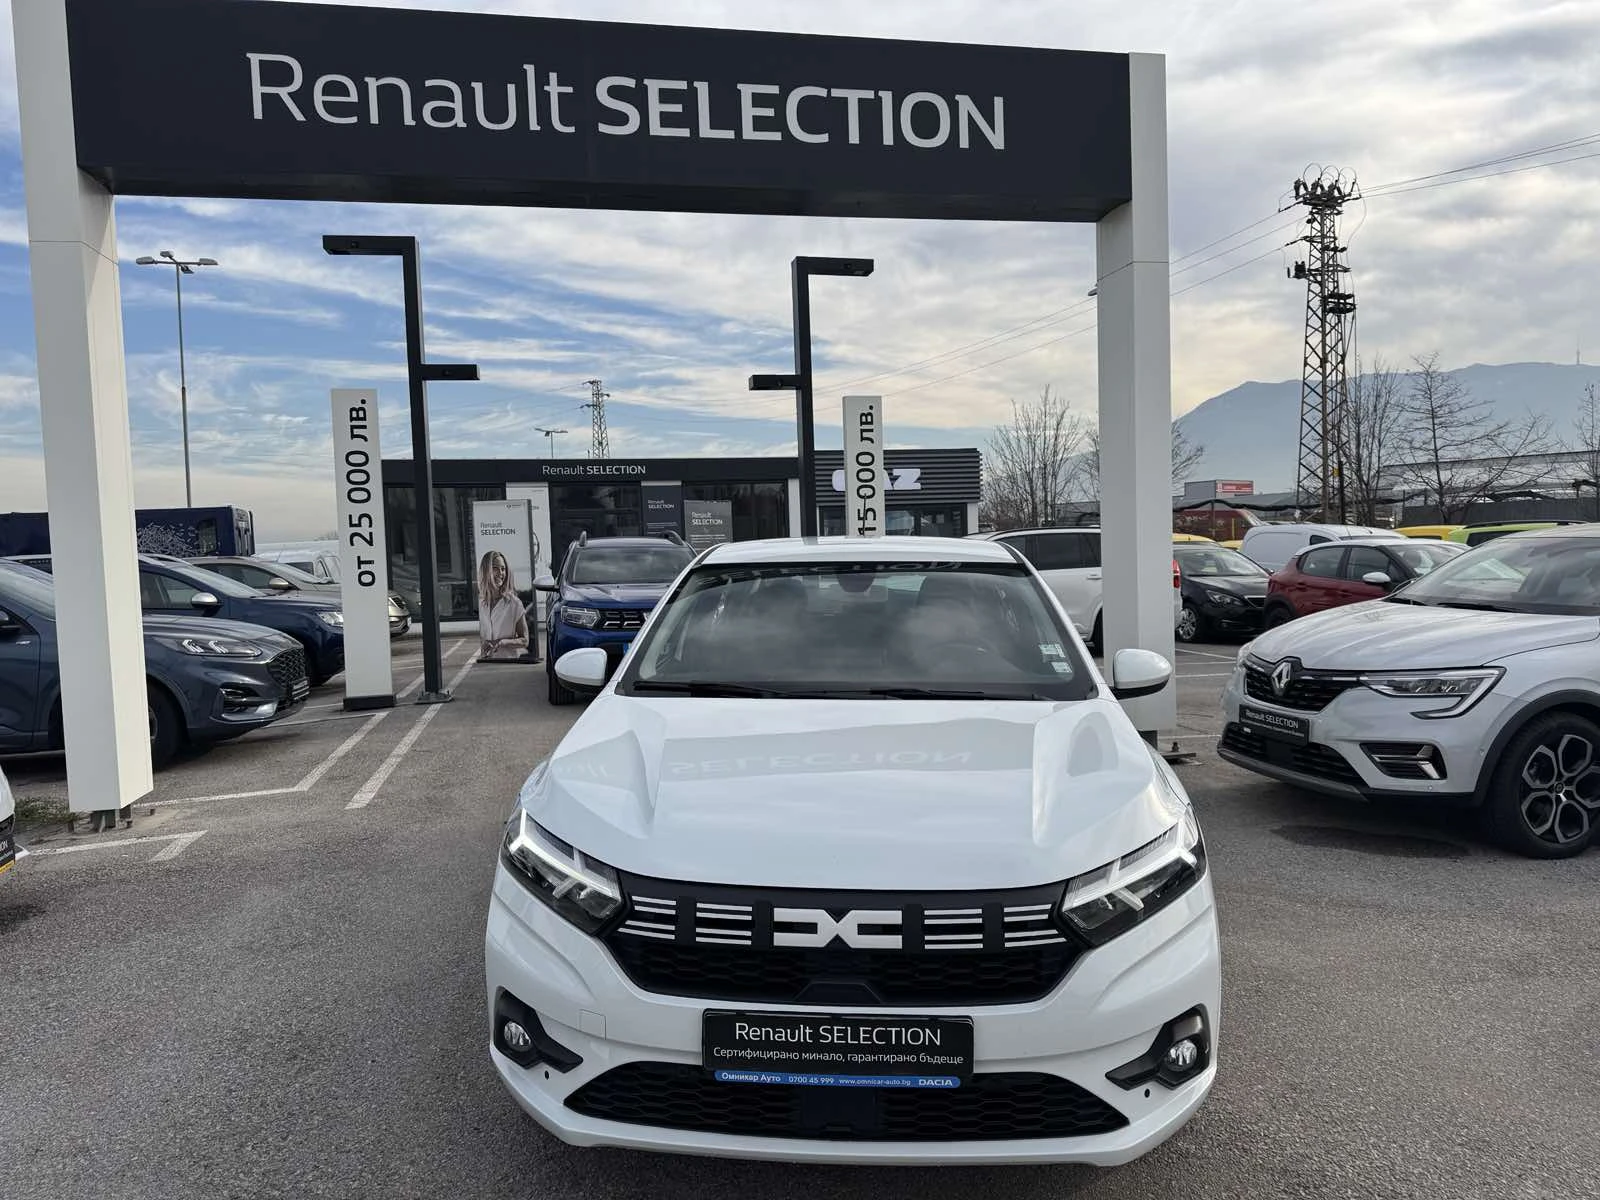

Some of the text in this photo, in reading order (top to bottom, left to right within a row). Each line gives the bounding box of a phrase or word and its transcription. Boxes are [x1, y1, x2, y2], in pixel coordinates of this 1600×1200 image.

[245, 52, 1005, 150] Renault SELECTION
[859, 404, 875, 444] лв.
[542, 465, 646, 475] Renault SELECTION
[855, 451, 876, 500] 000
[345, 399, 376, 587] от 25 000 лв.
[691, 518, 723, 526] SELECTION
[480, 528, 516, 536] SELECTION
[1265, 714, 1299, 729] SELECTION
[735, 1022, 941, 1047] Renault SELECTION
[713, 1046, 964, 1065] Сертифицирано минало, гарантирано бъдеще
[721, 1072, 953, 1087] Омникар Ауто 0700 45 999 www.omnicar-auto.bg DACIA
